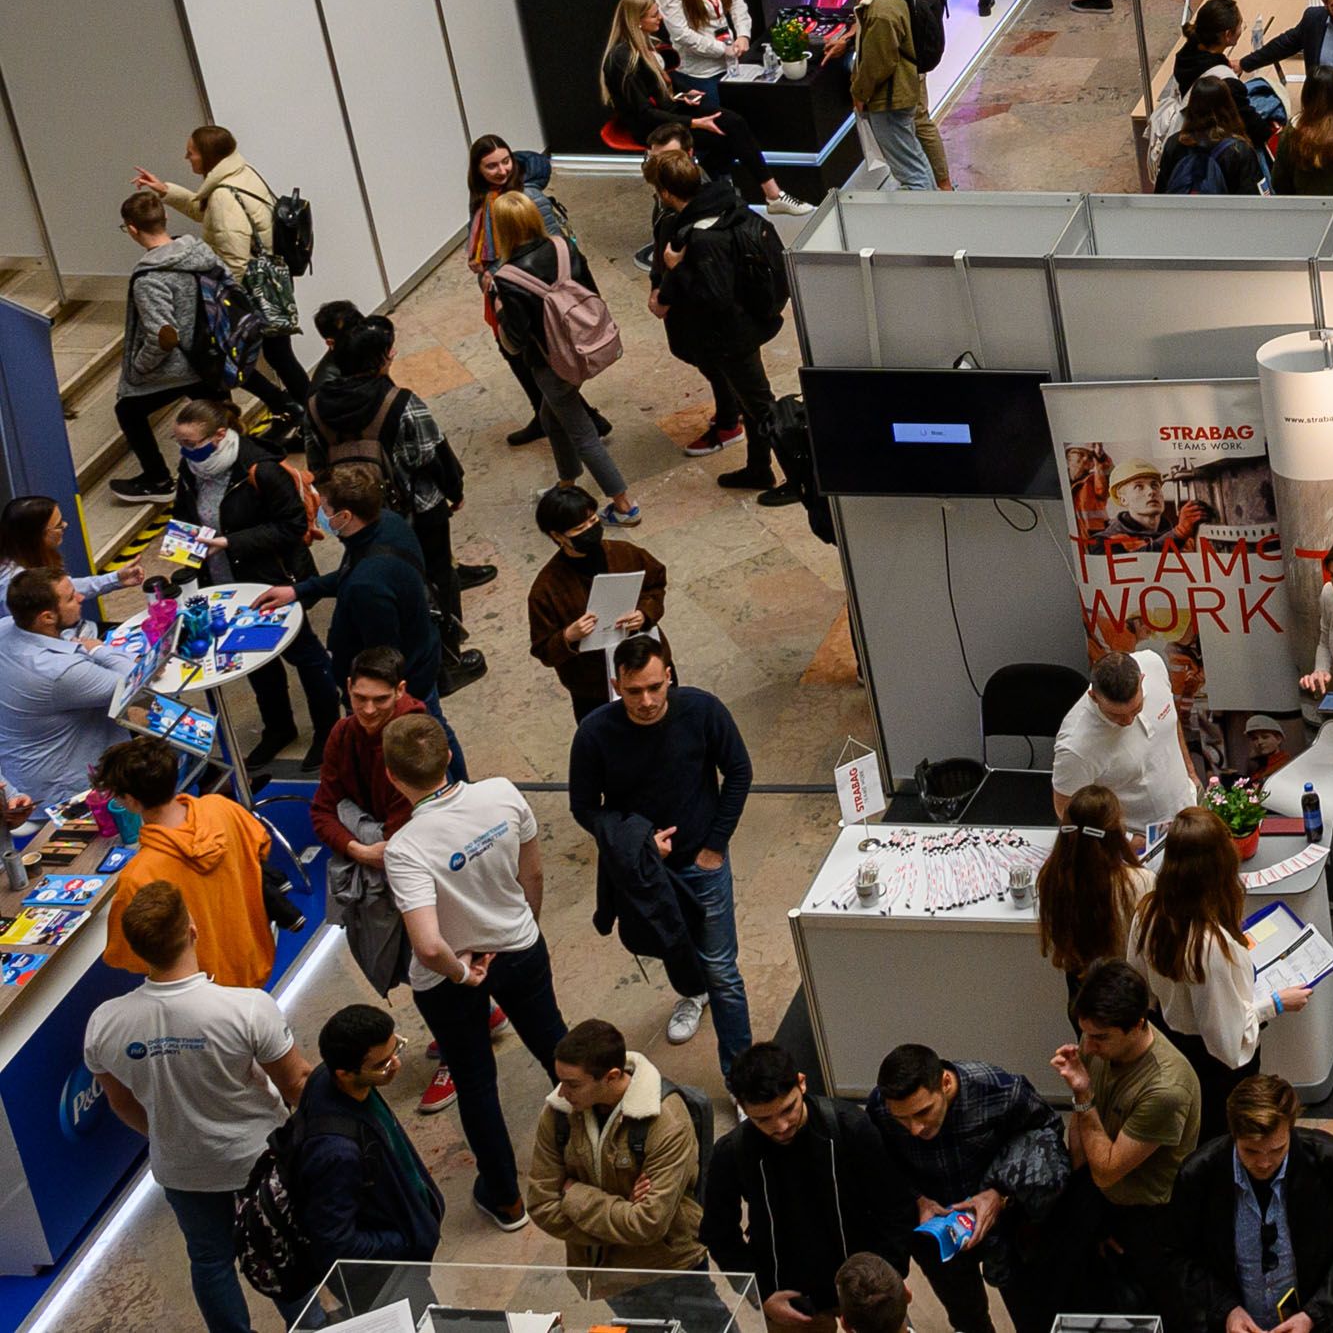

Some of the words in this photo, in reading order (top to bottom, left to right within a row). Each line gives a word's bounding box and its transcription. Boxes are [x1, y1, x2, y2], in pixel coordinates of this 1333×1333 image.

[1159, 425, 1255, 442] STRABAG
[1172, 442, 1207, 451] TEAMS
[1210, 441, 1246, 451] WORK.
[1079, 586, 1285, 635] WORK
[849, 767, 865, 813] STRABAG
